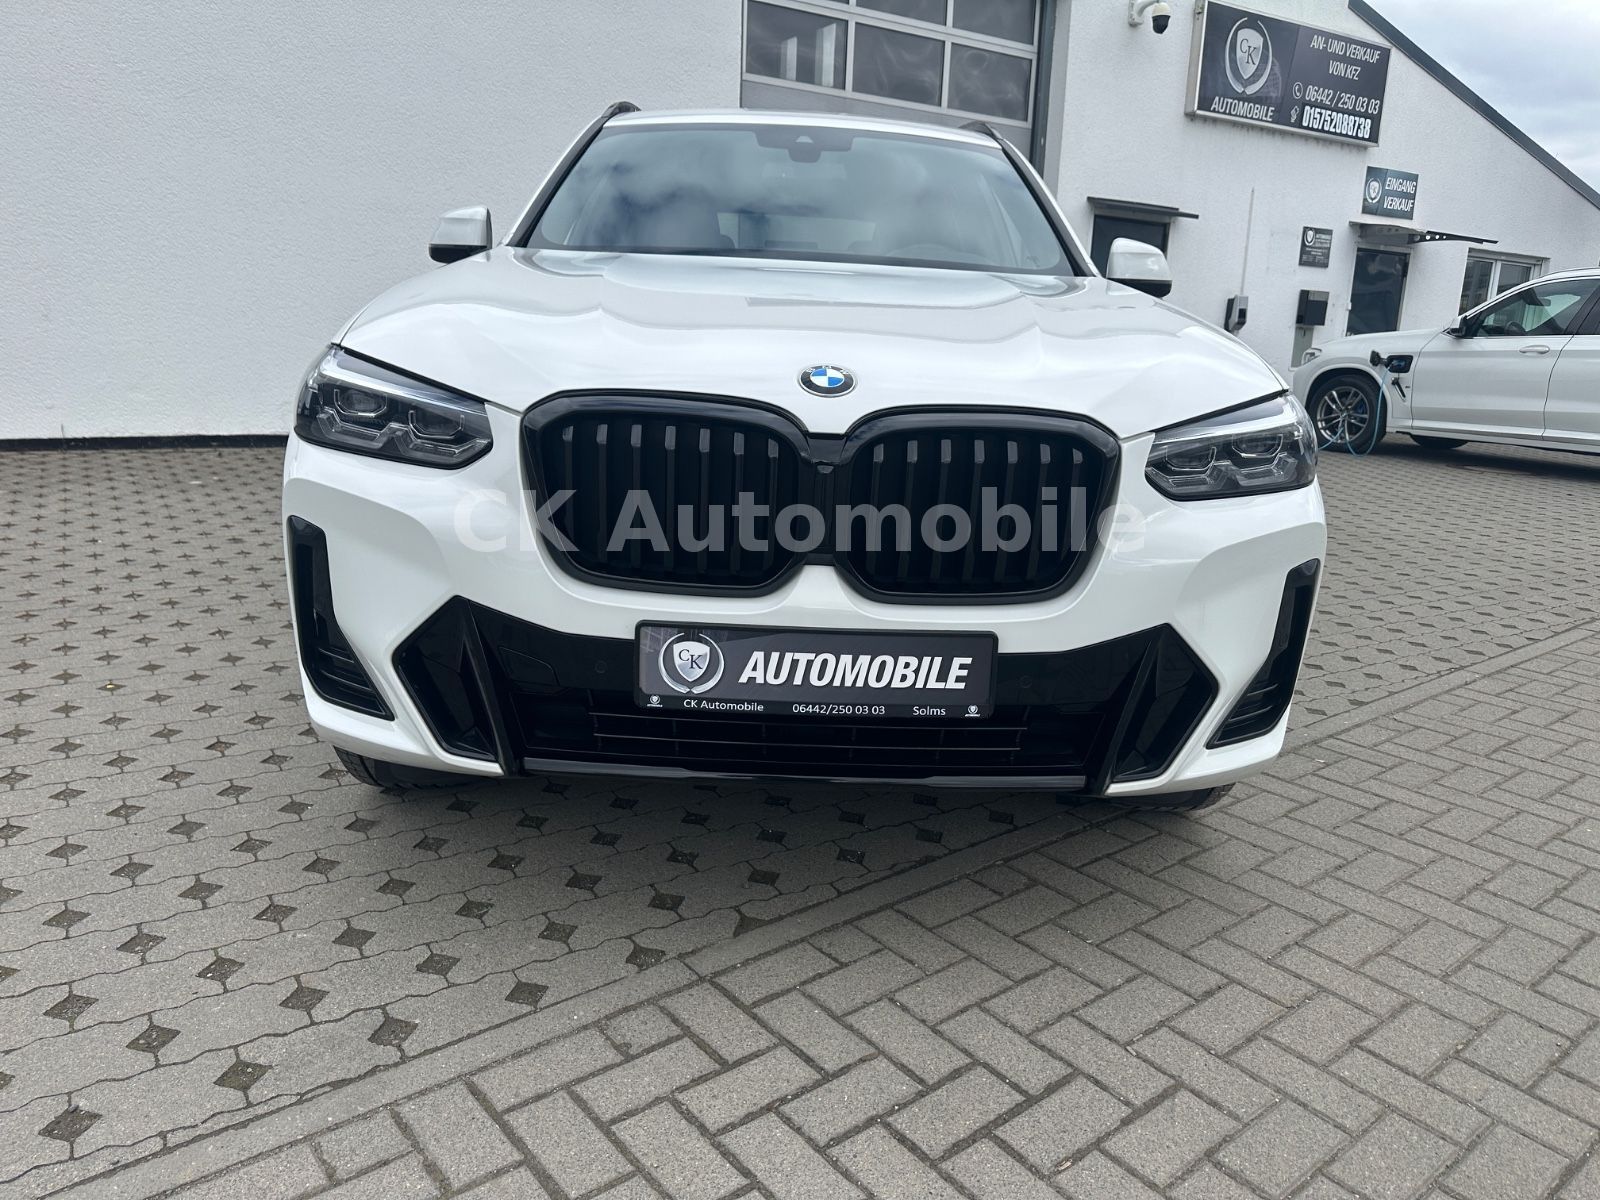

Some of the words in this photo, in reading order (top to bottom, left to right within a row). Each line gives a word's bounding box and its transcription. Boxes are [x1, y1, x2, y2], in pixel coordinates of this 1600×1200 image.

[1240, 38, 1258, 66] CK
[1310, 35, 1326, 50] AN-
[1327, 39, 1346, 55] UND
[1347, 43, 1381, 63] VERKAUF
[1328, 60, 1346, 76] VON
[1344, 64, 1361, 81] KFZ
[1211, 96, 1275, 122] AUTOMOBILE
[1305, 85, 1333, 106] 06442
[1338, 91, 1356, 110] 250
[1355, 95, 1368, 112] 03
[1368, 98, 1380, 115] 03
[1385, 177, 1417, 194] EINGANG
[1384, 196, 1414, 212] VERKAUF
[677, 648, 703, 670] CK
[737, 650, 973, 690] AUTOMOBILE
[683, 699, 698, 708] CK
[700, 699, 764, 712] Automobile
[792, 704, 854, 715] 06442/250
[855, 705, 870, 715] 03
[871, 705, 886, 715] 03
[912, 706, 946, 716] Solms
